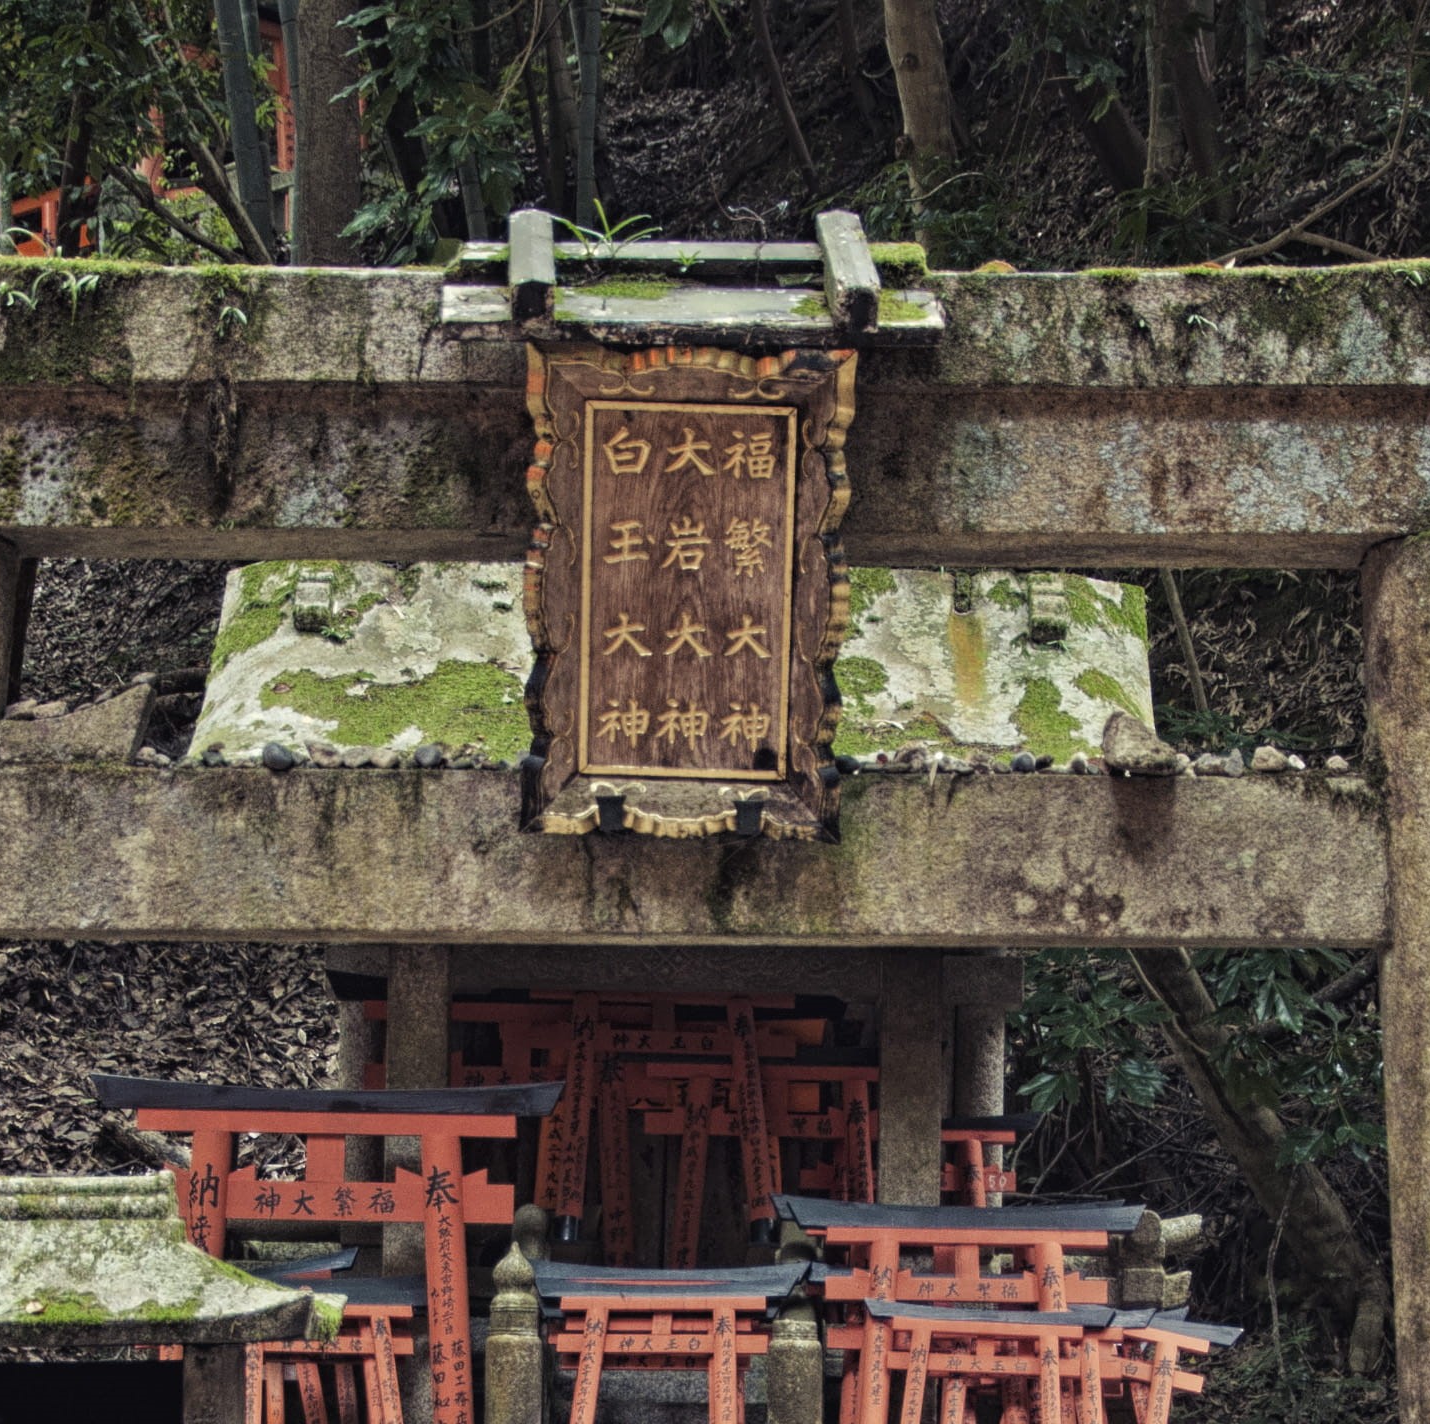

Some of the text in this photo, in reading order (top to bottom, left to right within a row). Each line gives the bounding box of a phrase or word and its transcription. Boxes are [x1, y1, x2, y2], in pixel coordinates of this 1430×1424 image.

[596, 426, 656, 748] 白玉大神
[654, 428, 714, 749] 大岩大神
[719, 430, 776, 752] 福繁大神
[189, 1163, 220, 1209] 納
[254, 1186, 395, 1217] 福繁大神
[425, 1165, 459, 1213] 奉
[986, 1174, 1008, 1193] 50
